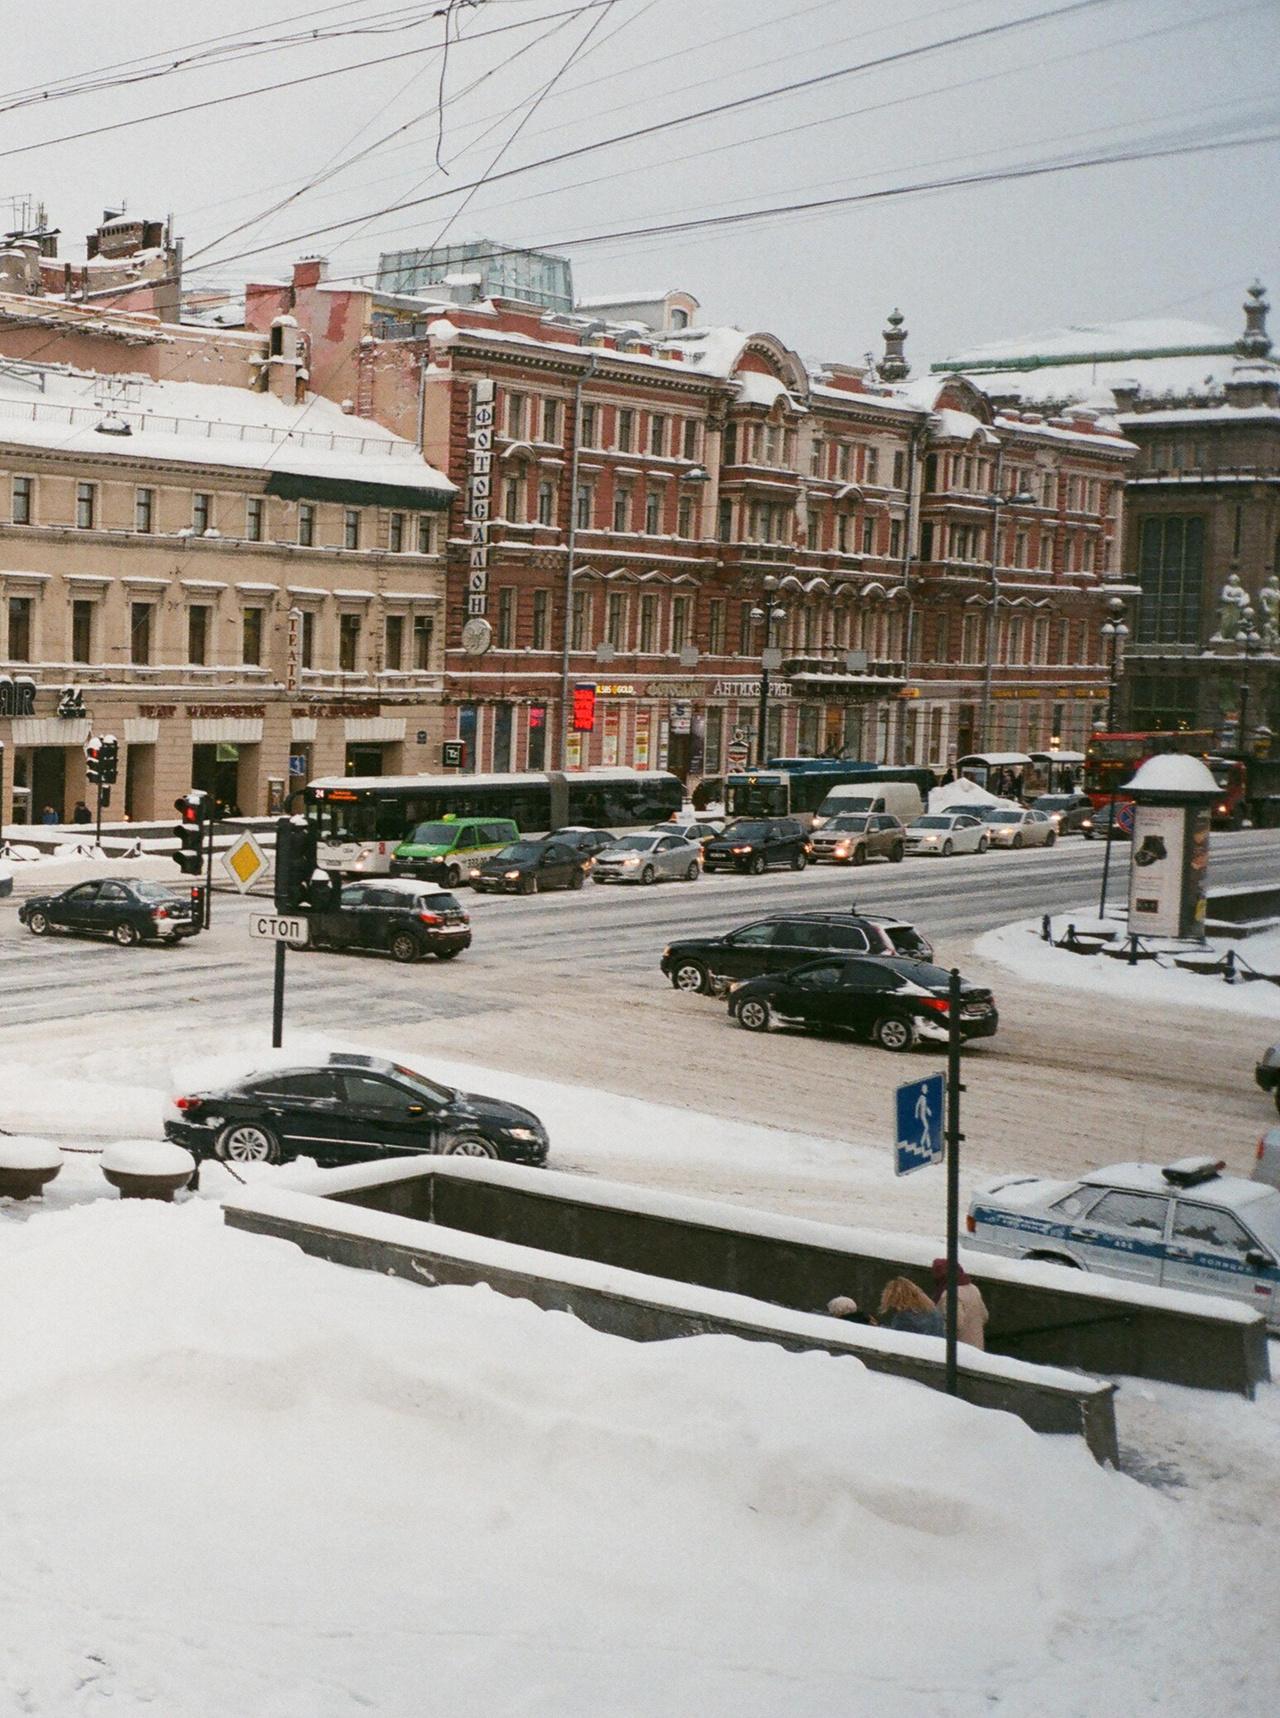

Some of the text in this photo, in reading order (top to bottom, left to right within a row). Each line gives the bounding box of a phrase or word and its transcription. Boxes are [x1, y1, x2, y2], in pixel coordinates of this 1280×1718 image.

[471, 408, 491, 613] ФОТОСАЛОН
[288, 619, 298, 690] ТЕАТР
[257, 918, 300, 938] СТОП
